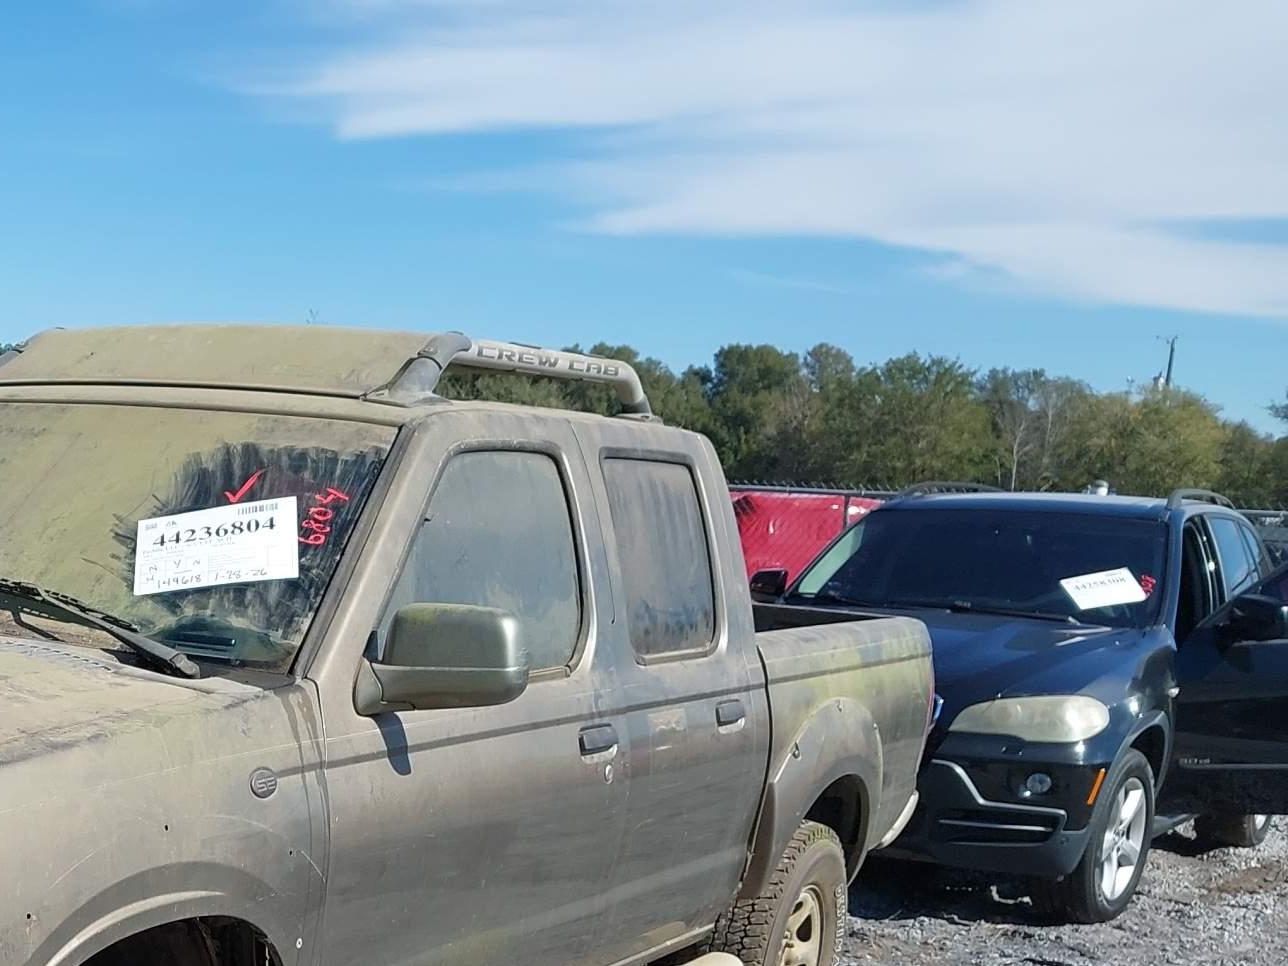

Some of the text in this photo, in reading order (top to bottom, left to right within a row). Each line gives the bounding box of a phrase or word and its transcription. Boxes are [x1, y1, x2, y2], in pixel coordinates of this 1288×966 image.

[476, 345, 620, 377] CREW CAB
[152, 516, 277, 547] 44236804
[298, 487, 350, 545] 6804
[257, 776, 275, 791] SE
